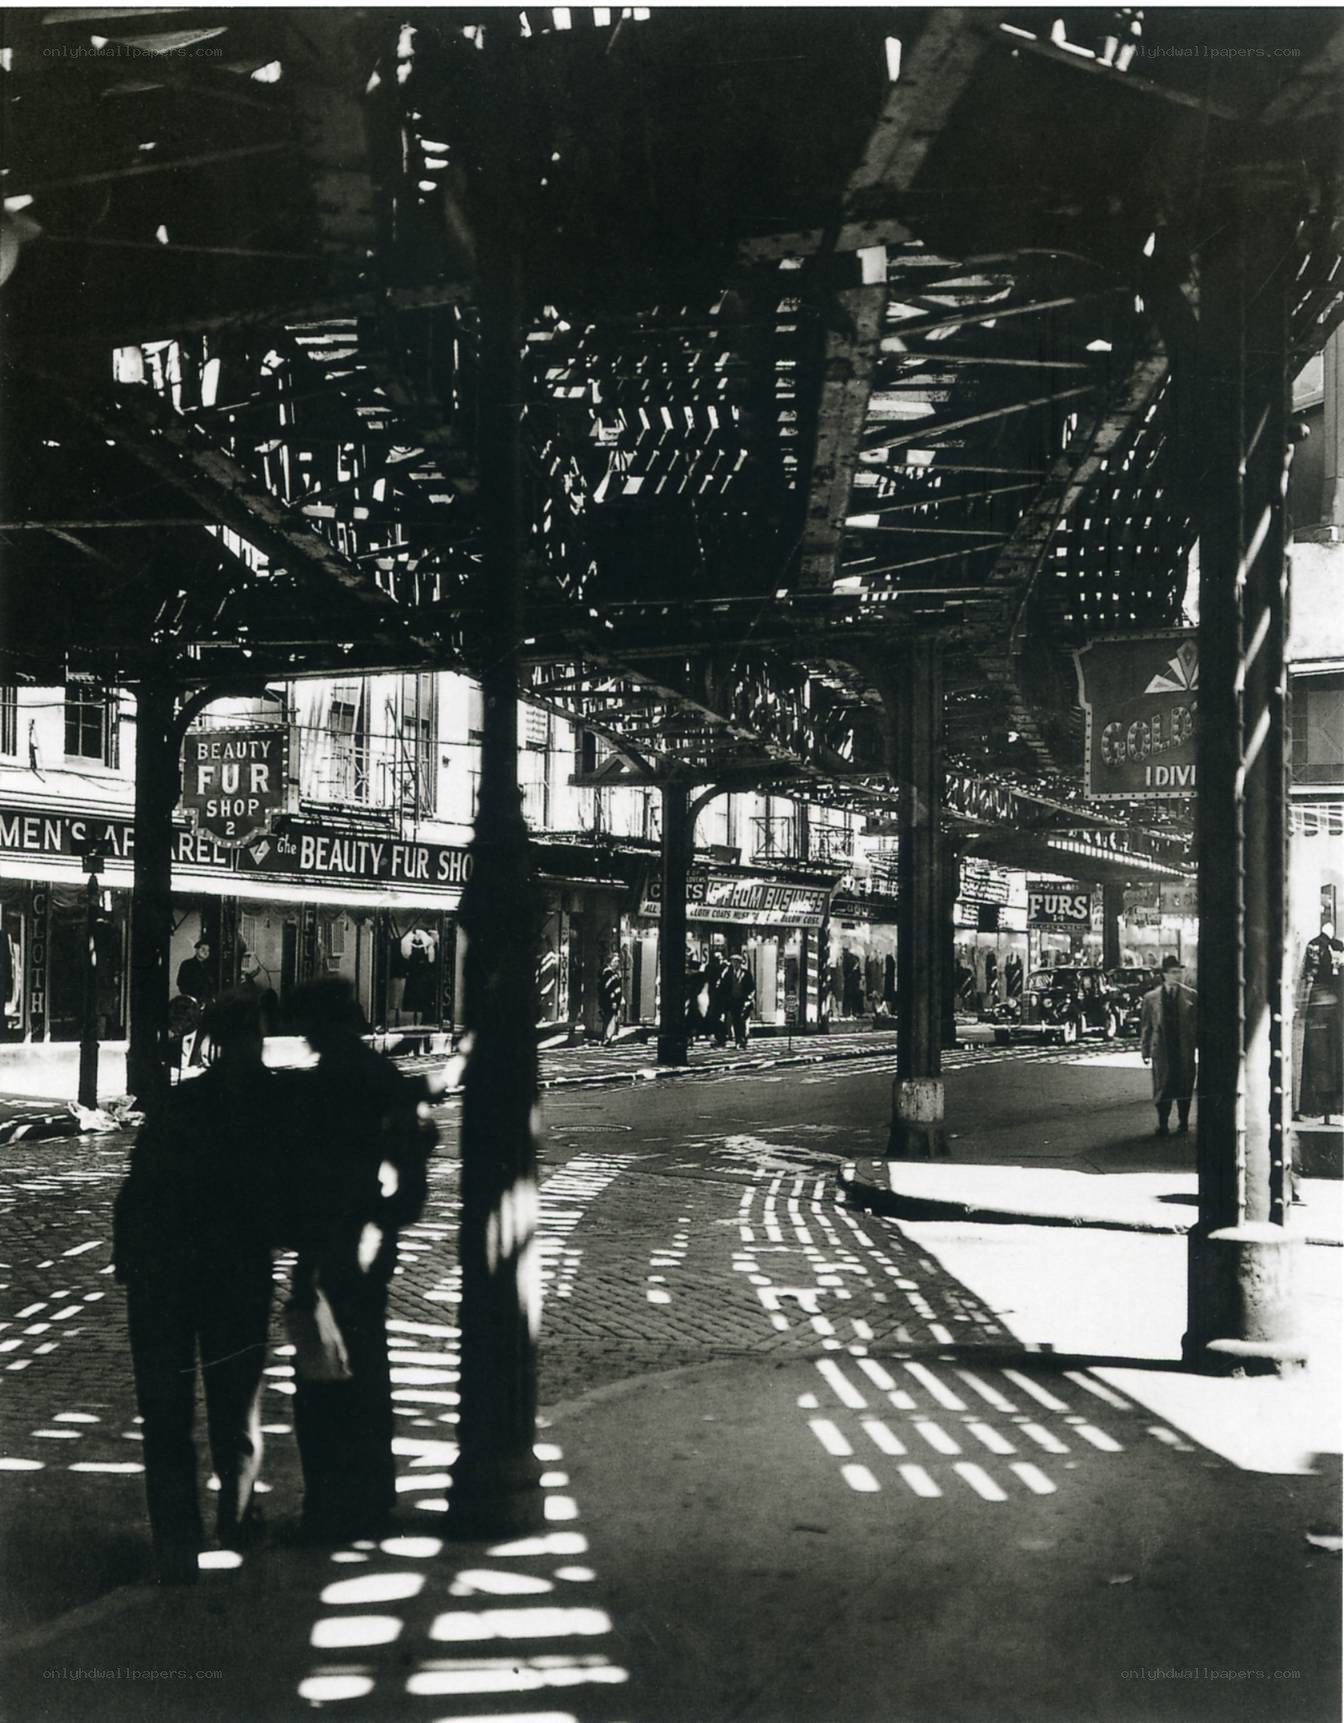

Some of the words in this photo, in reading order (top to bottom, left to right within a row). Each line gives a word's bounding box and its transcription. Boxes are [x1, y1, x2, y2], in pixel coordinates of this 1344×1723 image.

[197, 741, 271, 760] BEAUTY
[197, 763, 270, 796] FUR
[206, 799, 259, 817] SHOP
[225, 821, 235, 836] 2
[104, 825, 227, 864] APREL
[300, 836, 384, 876] BEAUTY
[391, 845, 430, 879] FUR
[650, 884, 704, 899] CTS
[1028, 894, 1088, 920] FURS
